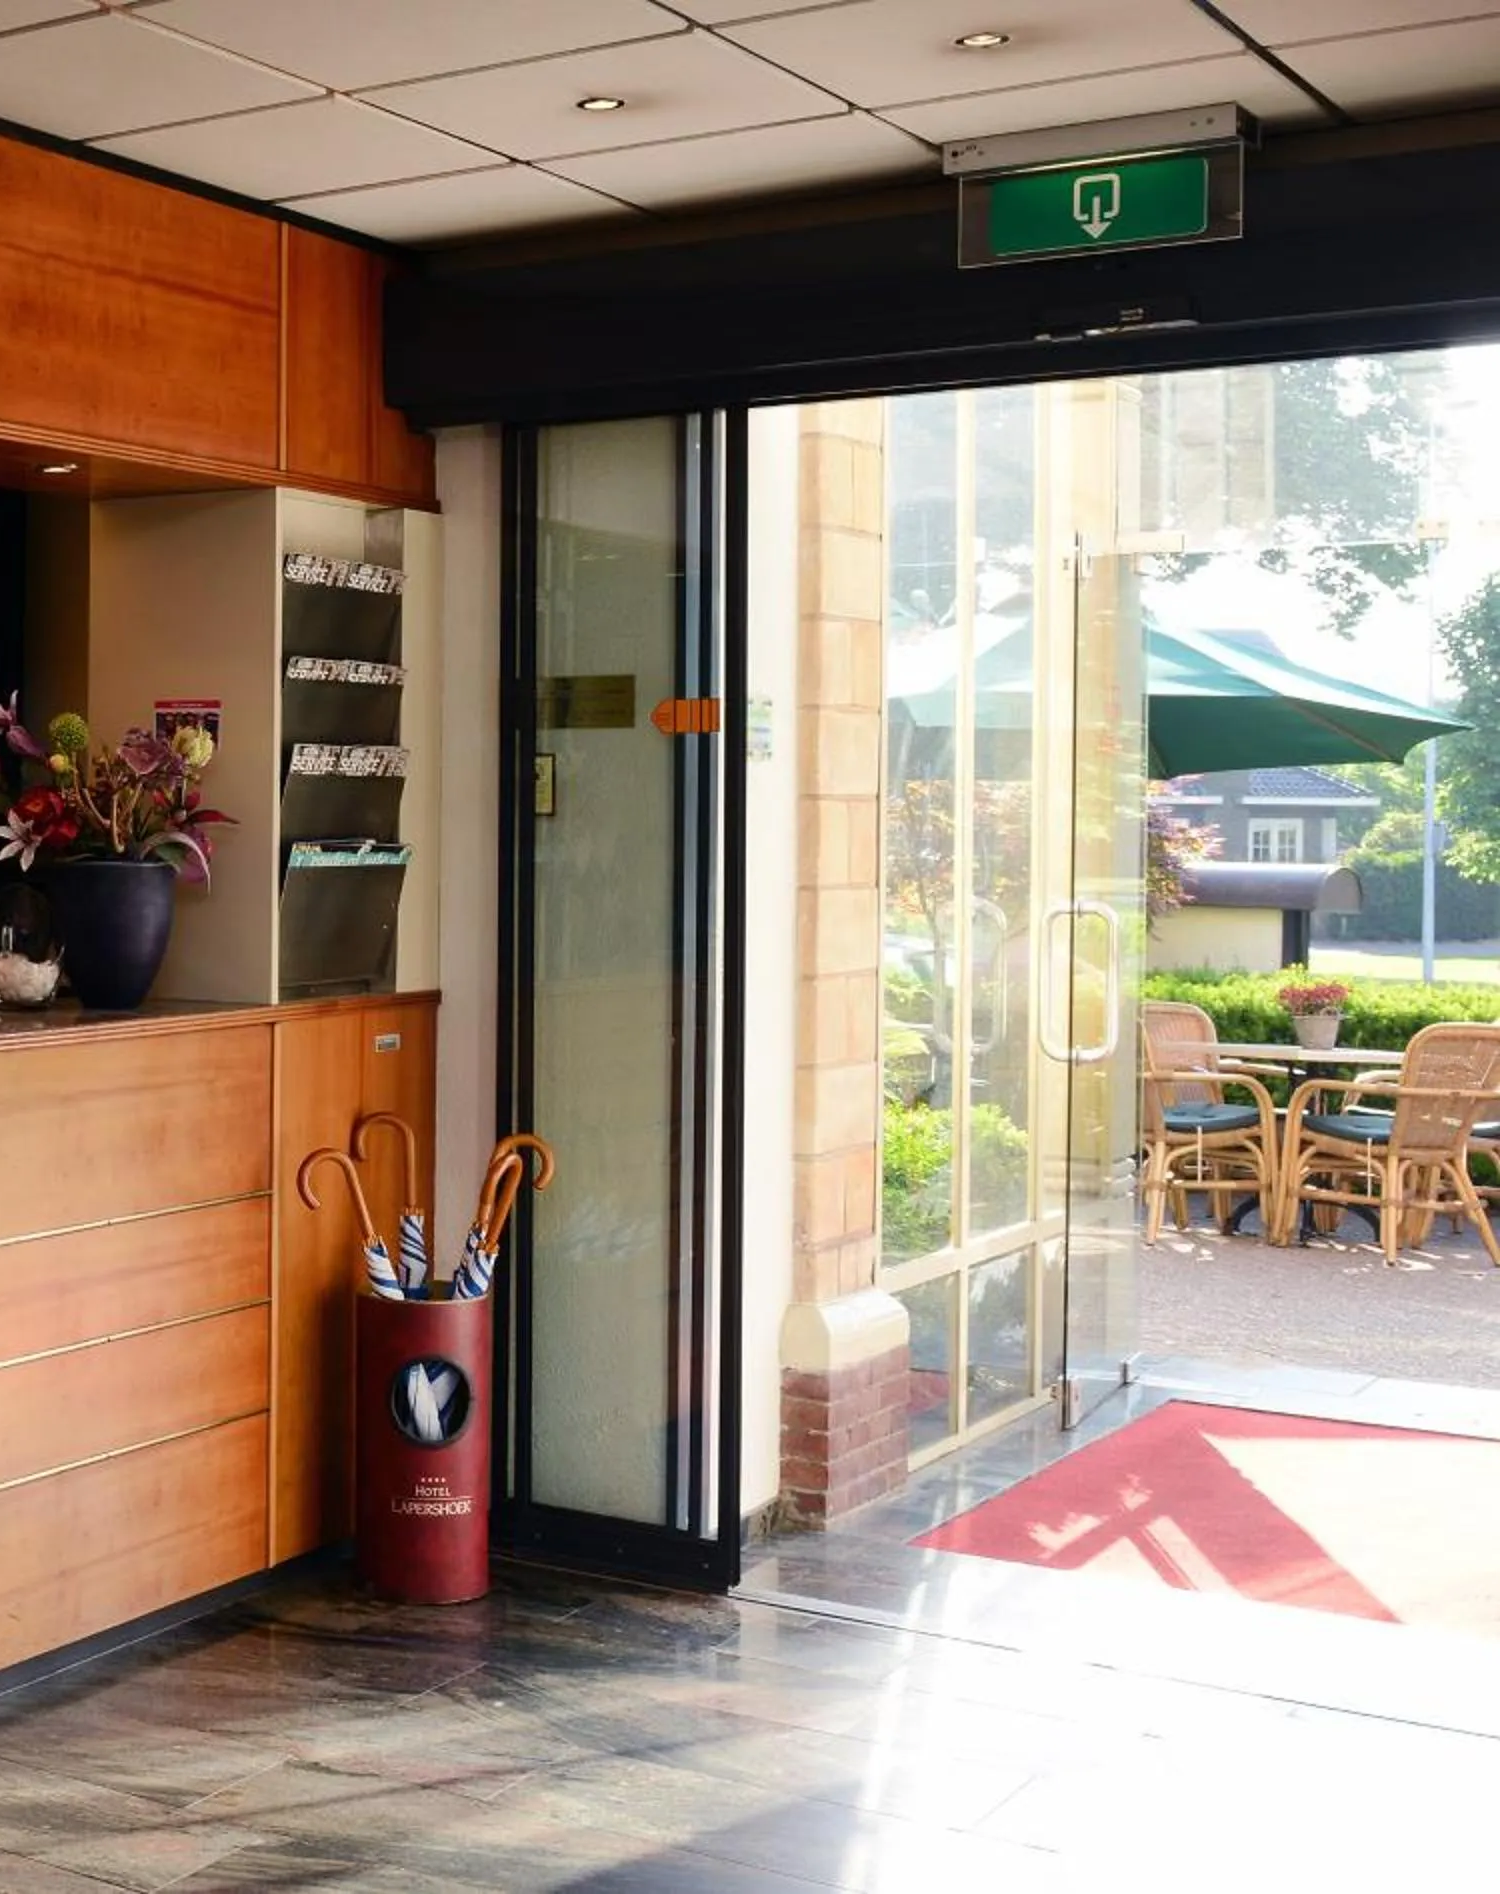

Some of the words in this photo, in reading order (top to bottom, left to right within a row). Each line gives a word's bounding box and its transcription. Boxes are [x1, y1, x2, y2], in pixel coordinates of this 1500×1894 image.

[283, 563, 329, 584] SERVICE
[346, 573, 389, 593] SERVICE
[414, 1484, 451, 1497] HOTEL
[391, 1499, 472, 1516] LAPERSHOEK
